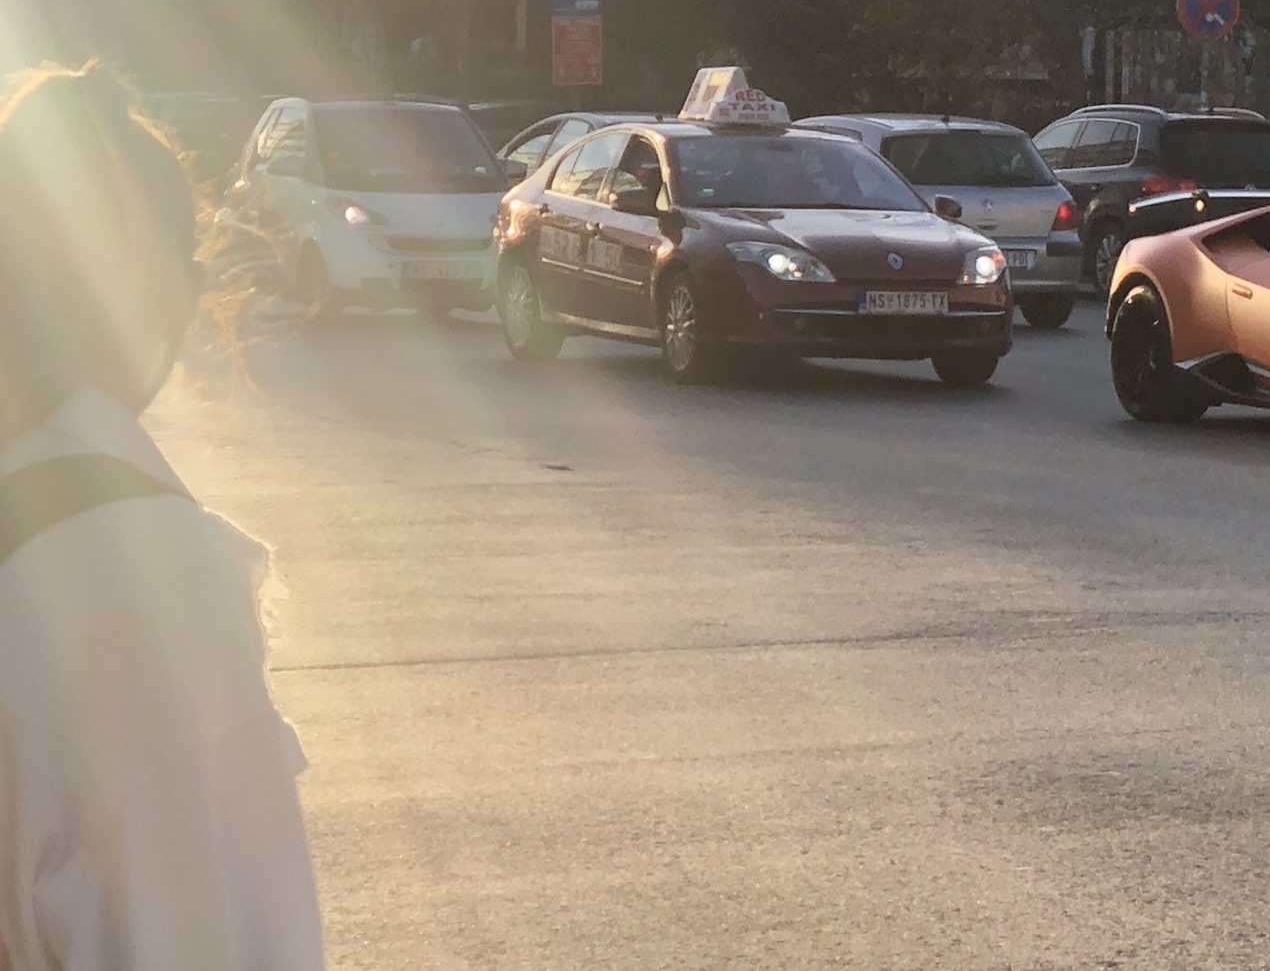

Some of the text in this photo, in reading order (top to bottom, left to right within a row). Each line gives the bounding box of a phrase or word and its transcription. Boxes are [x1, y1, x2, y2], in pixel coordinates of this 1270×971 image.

[735, 90, 766, 102] RED
[729, 102, 776, 112] TAXI
[869, 293, 885, 308] NS
